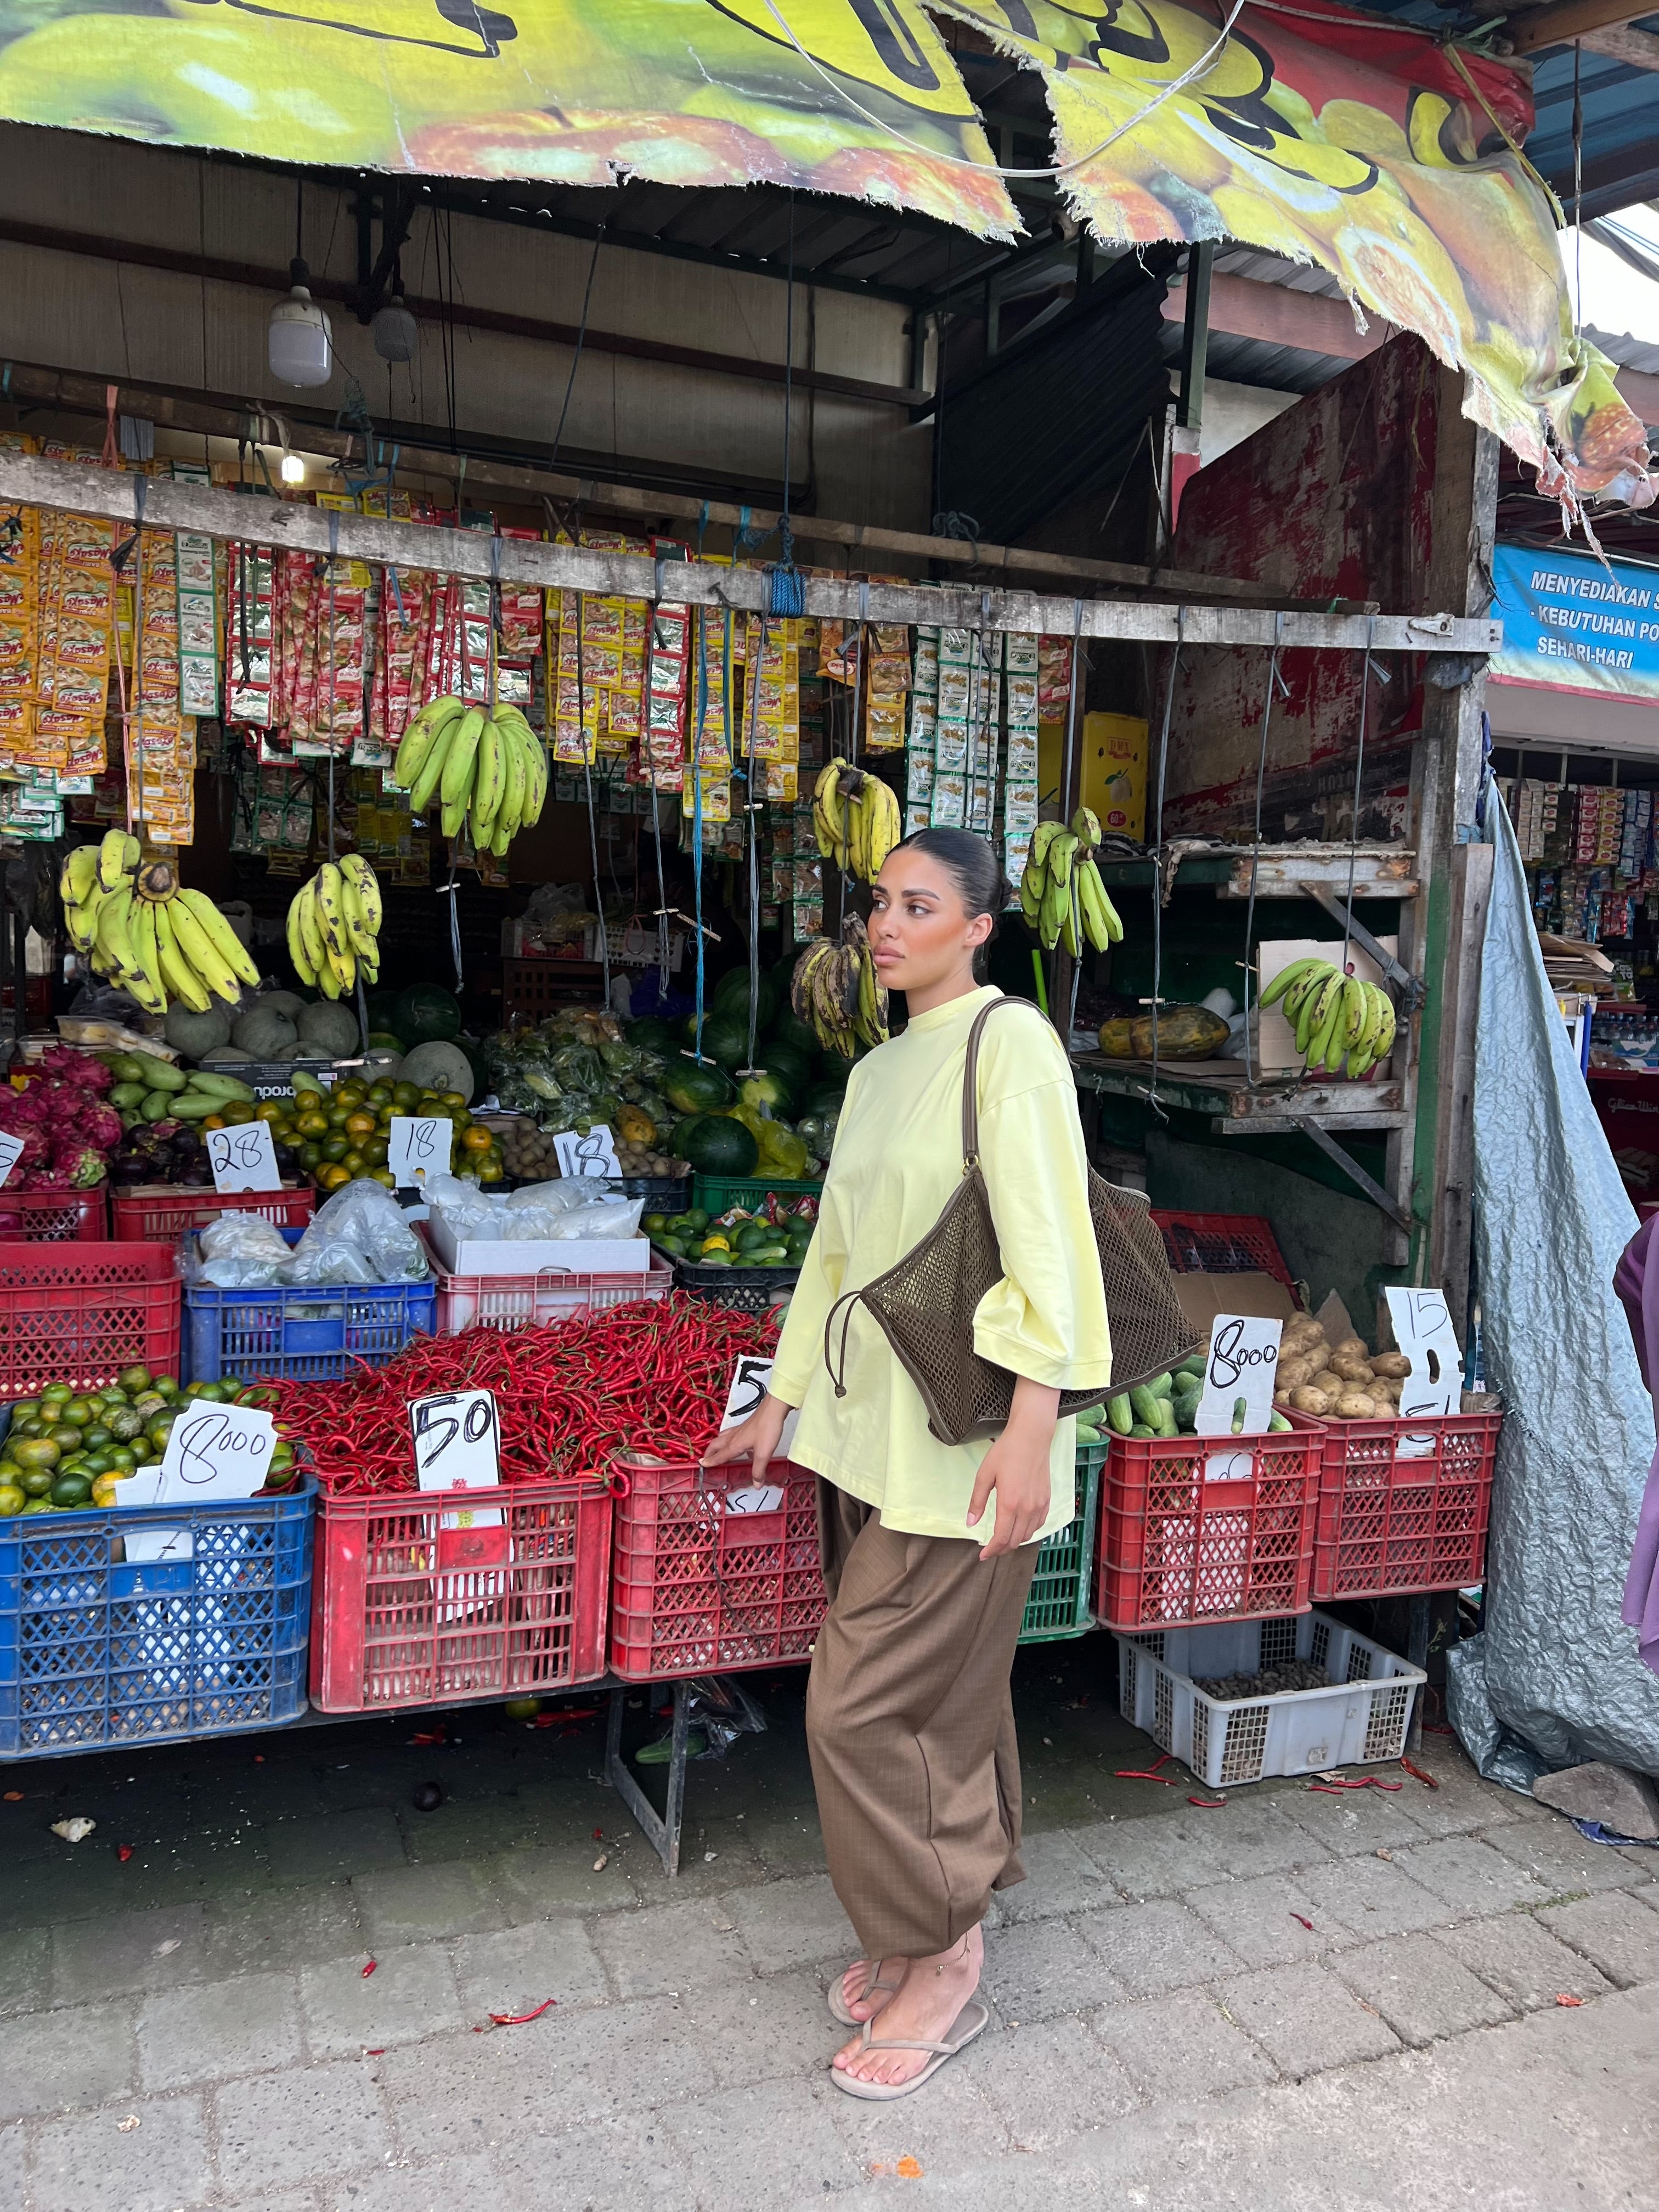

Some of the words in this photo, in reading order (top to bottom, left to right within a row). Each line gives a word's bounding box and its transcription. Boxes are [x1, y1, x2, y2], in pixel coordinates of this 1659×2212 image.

[1530, 571, 1652, 608] MENYEDIAKAN
[1538, 605, 1635, 638] KEBUTUHAN
[1537, 636, 1634, 669] SEHARI-HARI
[1110, 812, 1119, 824] 60
[405, 1120, 437, 1160] 18
[563, 1132, 611, 1177] 18
[1406, 1292, 1448, 1340] 15
[1209, 1319, 1277, 1389] 8000
[179, 1414, 267, 1485] 8000
[414, 1396, 492, 1469] 50
